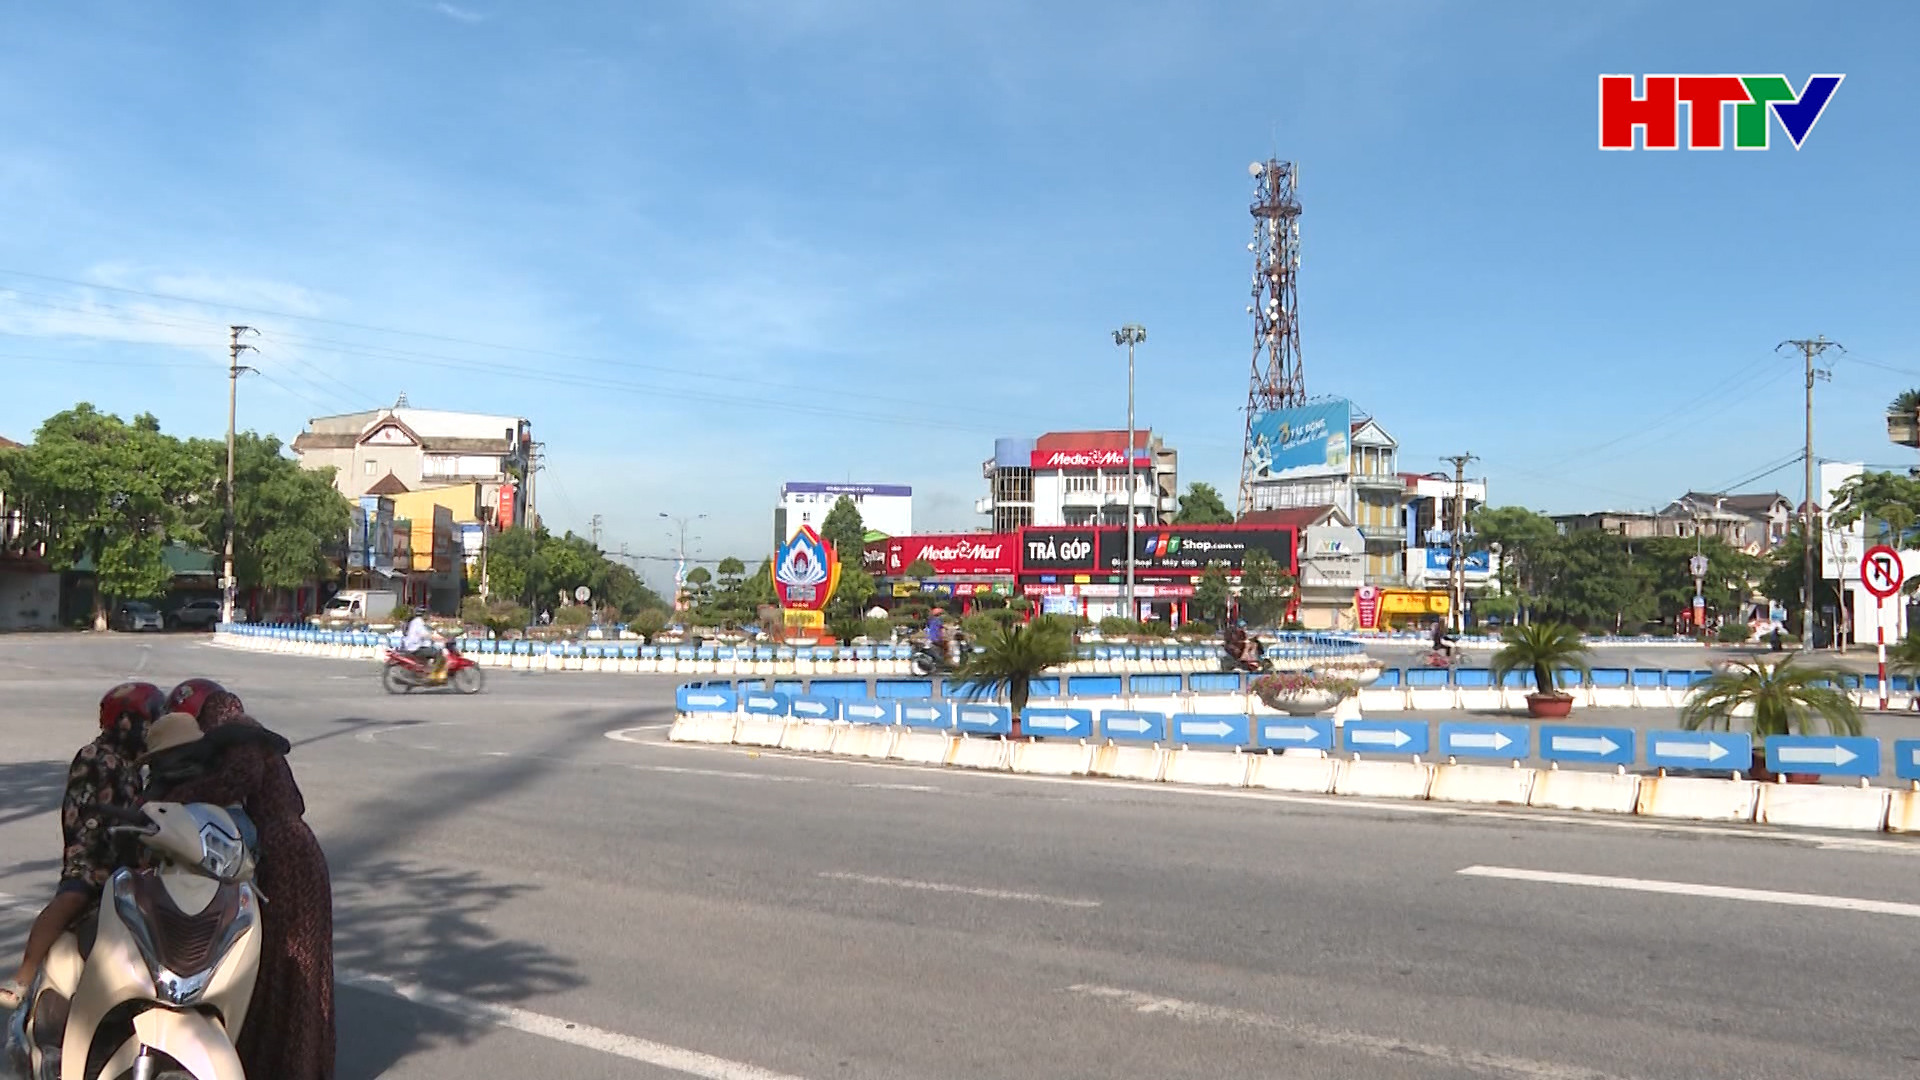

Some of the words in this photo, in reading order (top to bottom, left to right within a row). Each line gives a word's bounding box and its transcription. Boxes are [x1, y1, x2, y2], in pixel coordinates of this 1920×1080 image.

[1047, 452, 1089, 465] Media
[917, 545, 959, 560] Media
[968, 544, 1002, 560] Mart
[1028, 535, 1056, 560] TRẢ
[1060, 536, 1091, 561] GÓP
[1145, 535, 1180, 554] FPT
